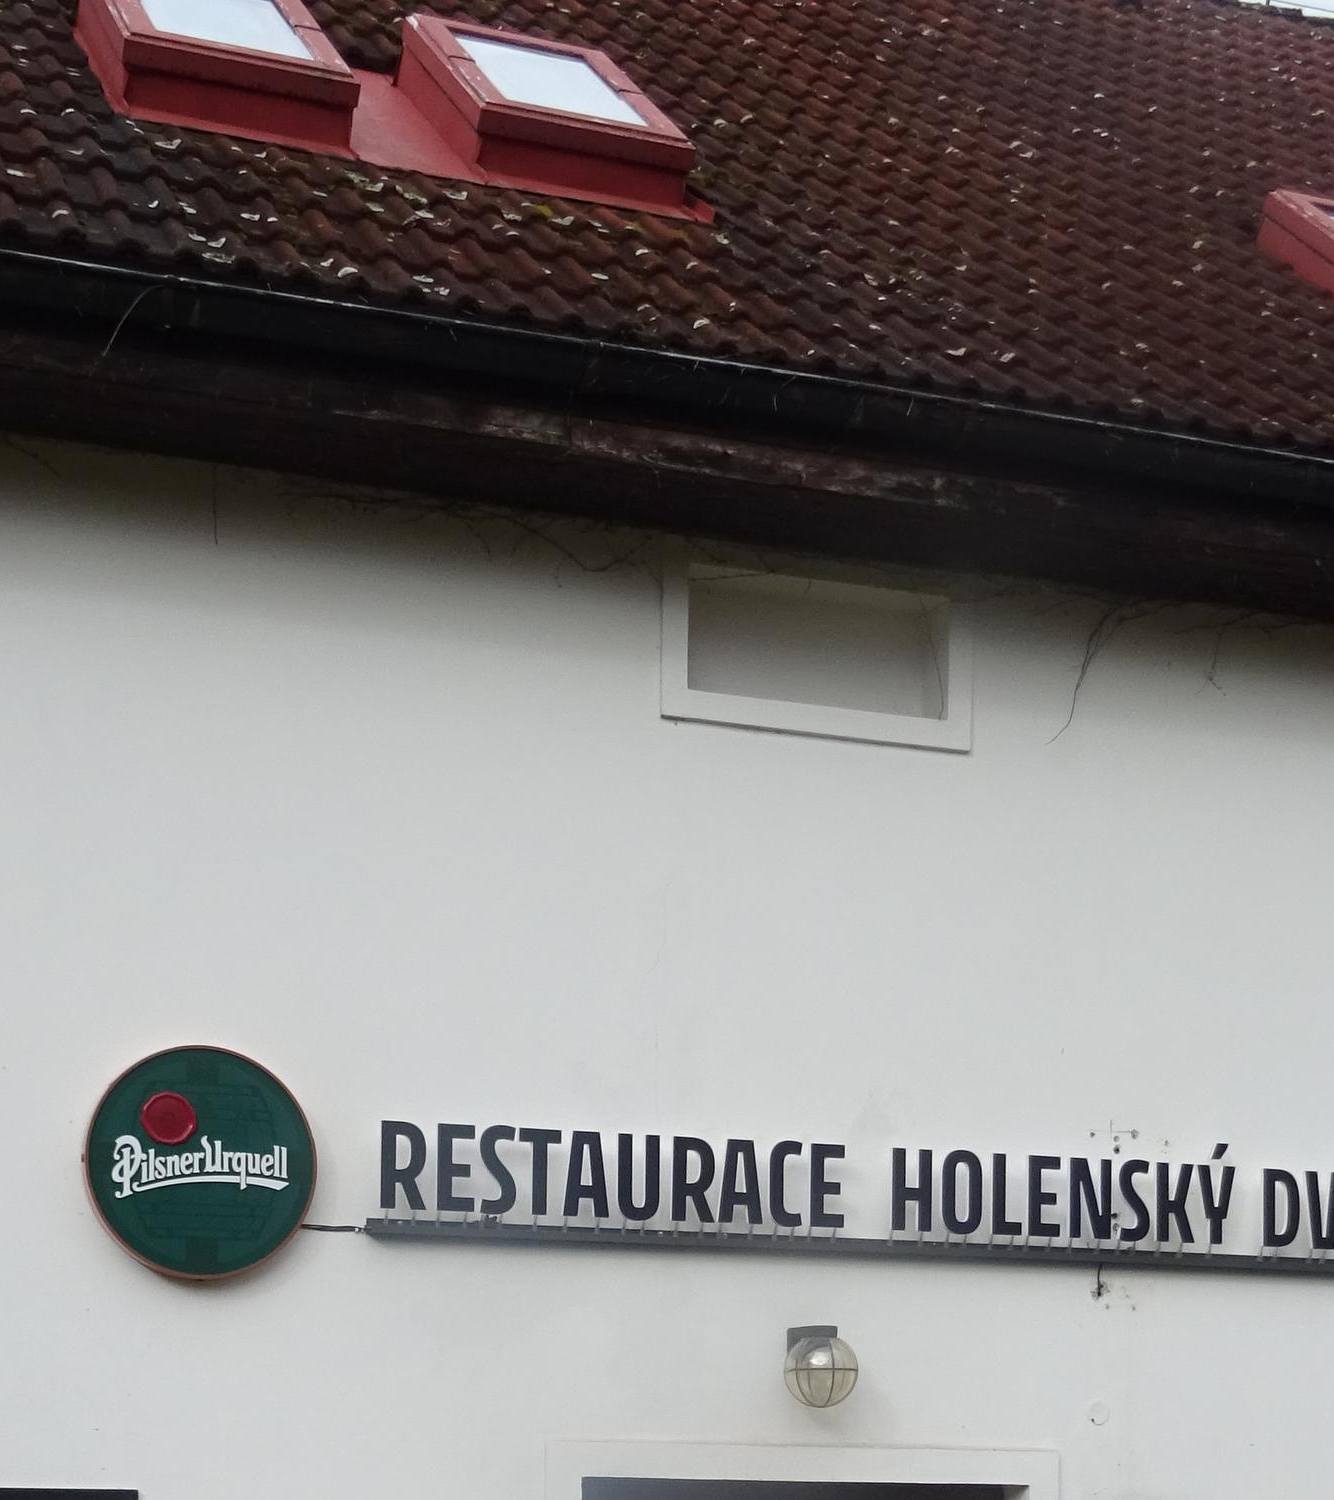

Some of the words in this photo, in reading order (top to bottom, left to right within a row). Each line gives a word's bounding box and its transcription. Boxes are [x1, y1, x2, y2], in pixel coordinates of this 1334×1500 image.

[111, 1134, 205, 1199] Pilsner
[201, 1134, 288, 1191] Urquell
[379, 1119, 846, 1228] RESTAURACE
[890, 1142, 1236, 1245] HOLENSKÝ
